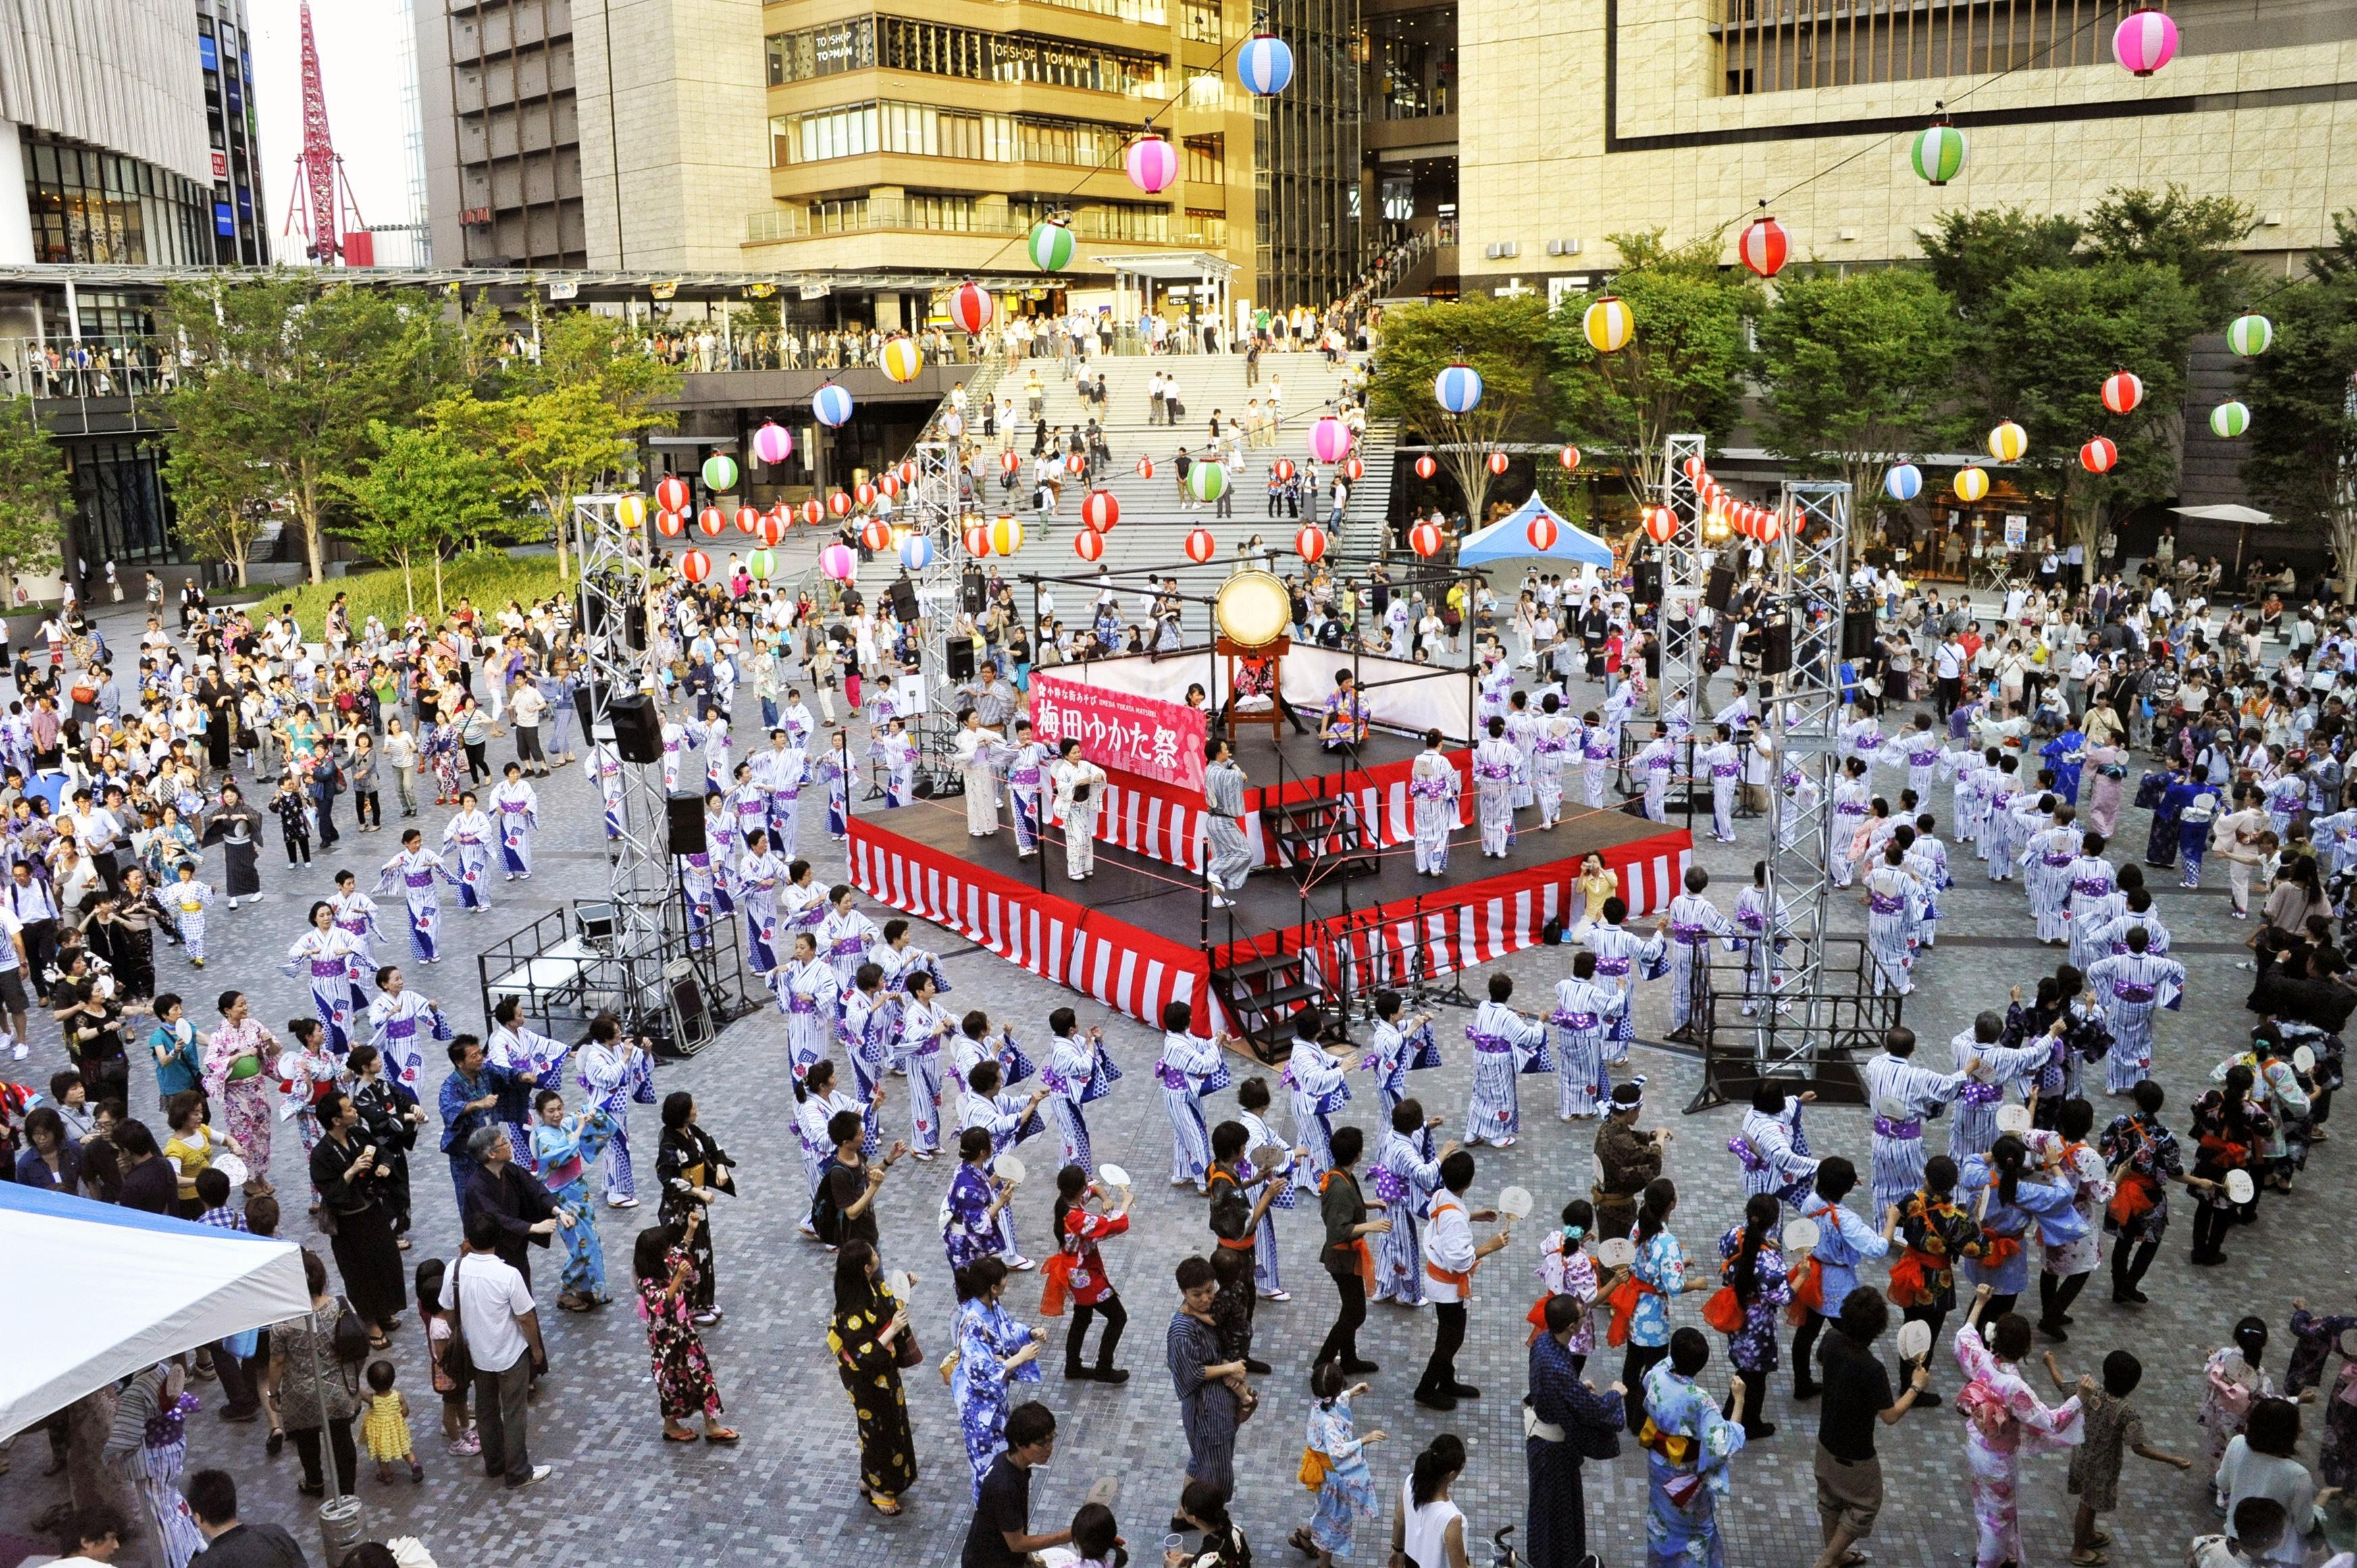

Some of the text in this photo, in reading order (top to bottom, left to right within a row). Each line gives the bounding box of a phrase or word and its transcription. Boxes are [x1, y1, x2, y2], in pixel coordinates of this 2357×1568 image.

[816, 31, 852, 48] TOSHOP
[213, 156, 224, 165] UNI
[1099, 699, 1157, 718] UMEDA YUKATA MATSURI
[1037, 698, 1179, 768] 梅田ゆかた祭
